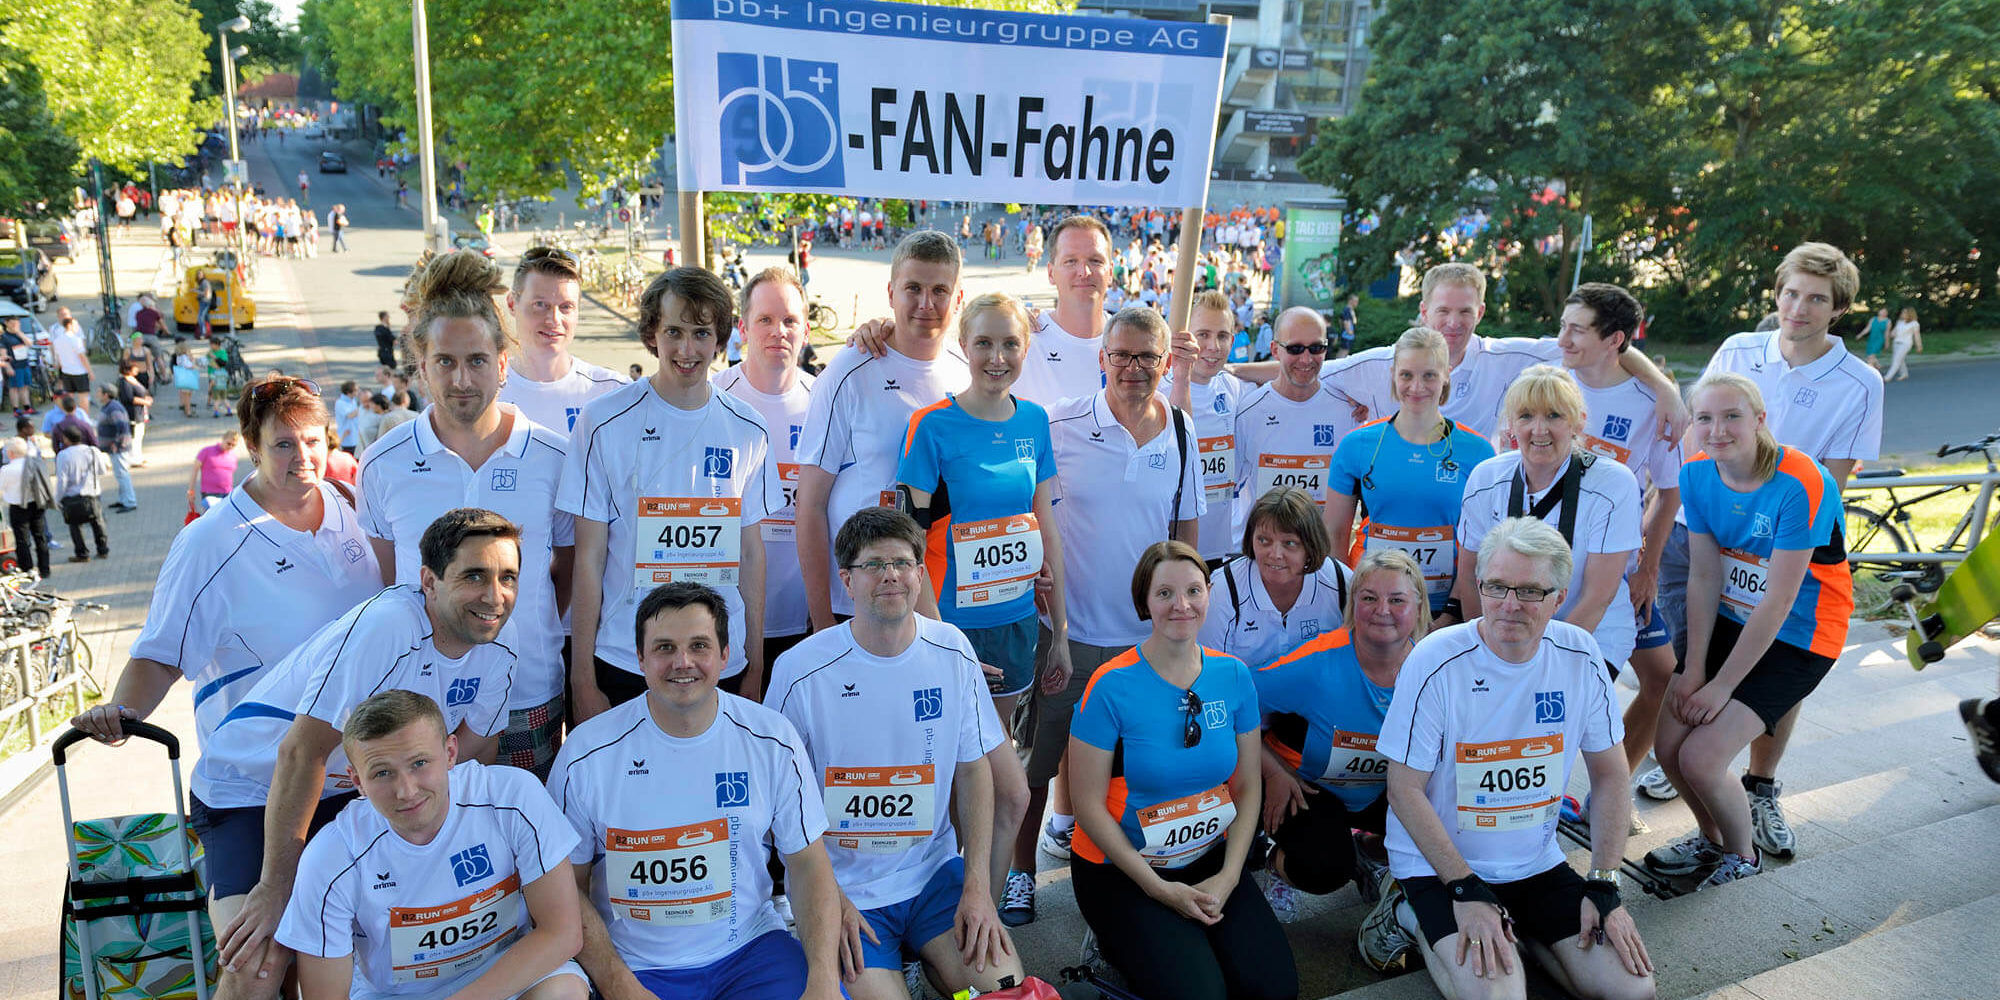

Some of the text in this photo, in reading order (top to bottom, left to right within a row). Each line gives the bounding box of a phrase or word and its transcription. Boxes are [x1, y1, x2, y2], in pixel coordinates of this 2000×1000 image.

[713, 0, 1199, 50] pb+ Ingenieurgruppe AG
[1272, 474, 1320, 491] 4054
[658, 525, 723, 549] 4057
[974, 541, 1028, 568] 4053
[834, 772, 866, 781] B2RUN
[1345, 756, 1390, 774] 406
[1480, 765, 1547, 793] 4065
[845, 793, 914, 819] 4062
[1147, 806, 1176, 819] B2RUN
[616, 836, 649, 846] B2RUN
[1165, 817, 1220, 848] 4066
[630, 855, 708, 885] 4056
[373, 880, 397, 890] erima
[401, 910, 441, 922] B2RUN
[418, 911, 498, 949] 4052
